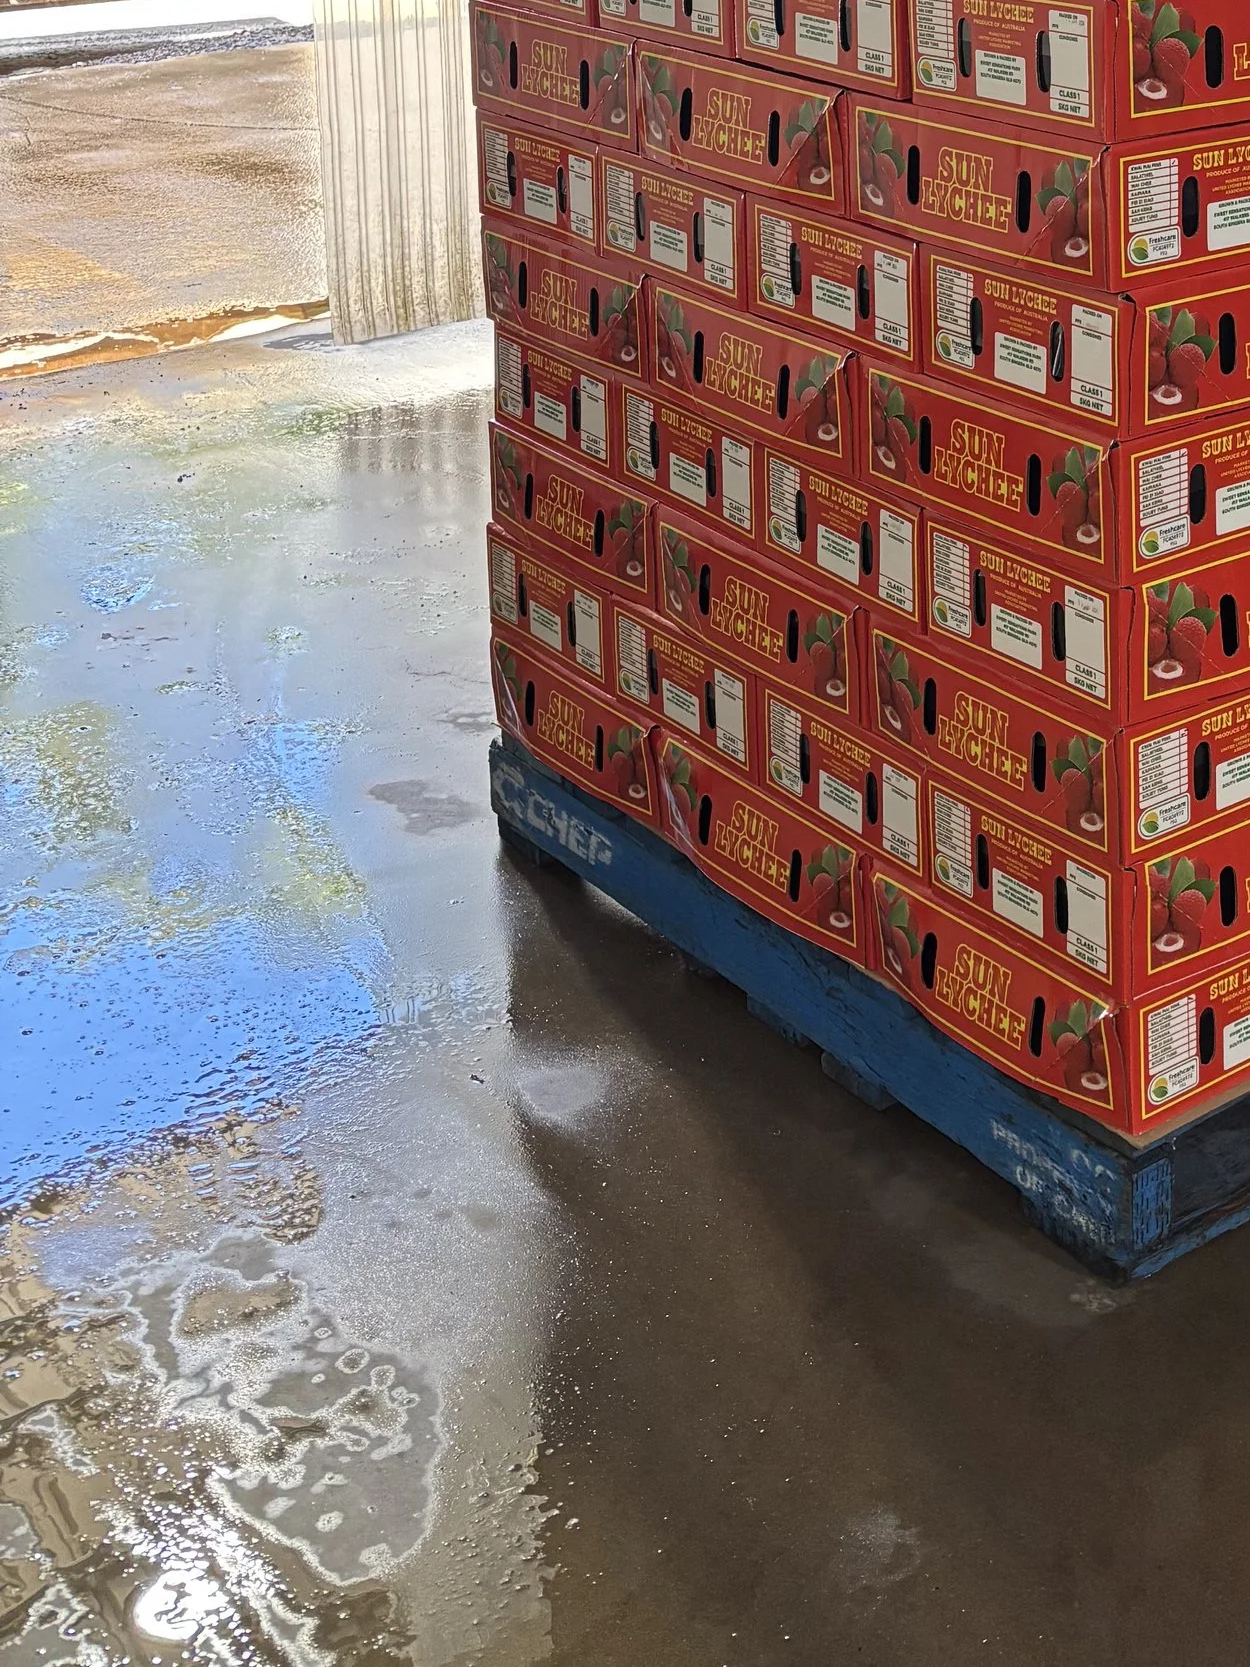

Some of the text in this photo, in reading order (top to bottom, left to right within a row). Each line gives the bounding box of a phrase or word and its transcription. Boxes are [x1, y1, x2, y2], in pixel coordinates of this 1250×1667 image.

[989, 0, 1034, 24] LYCHEE
[708, 89, 752, 132] SUN
[693, 115, 764, 166] LYCHEE
[1193, 149, 1224, 171] SUN
[937, 147, 995, 193] SUN
[1206, 168, 1231, 179] PRODUCE
[921, 178, 1010, 233] LYCHEE
[1149, 233, 1176, 244] Freshcare
[984, 277, 1056, 316] SUN LYCHEE
[1080, 384, 1098, 396] CLASS
[1080, 397, 1102, 411] 5KG NET
[950, 419, 1006, 470] SUN
[1202, 434, 1233, 459] SUN
[933, 450, 1025, 513] LYCHEE
[724, 576, 772, 625] SUN
[710, 604, 785, 663] LYCHEE
[547, 693, 585, 735] SUN
[953, 692, 1011, 745] SUN
[537, 717, 595, 771] LYCHEE
[937, 720, 1028, 789] LYCHEE
[1159, 799, 1186, 816] Freshcare
[955, 944, 1012, 996] SUN
[1210, 971, 1239, 1001] SUN
[936, 973, 1027, 1049] LYCHEE
[1169, 1062, 1194, 1081] Freshcare
